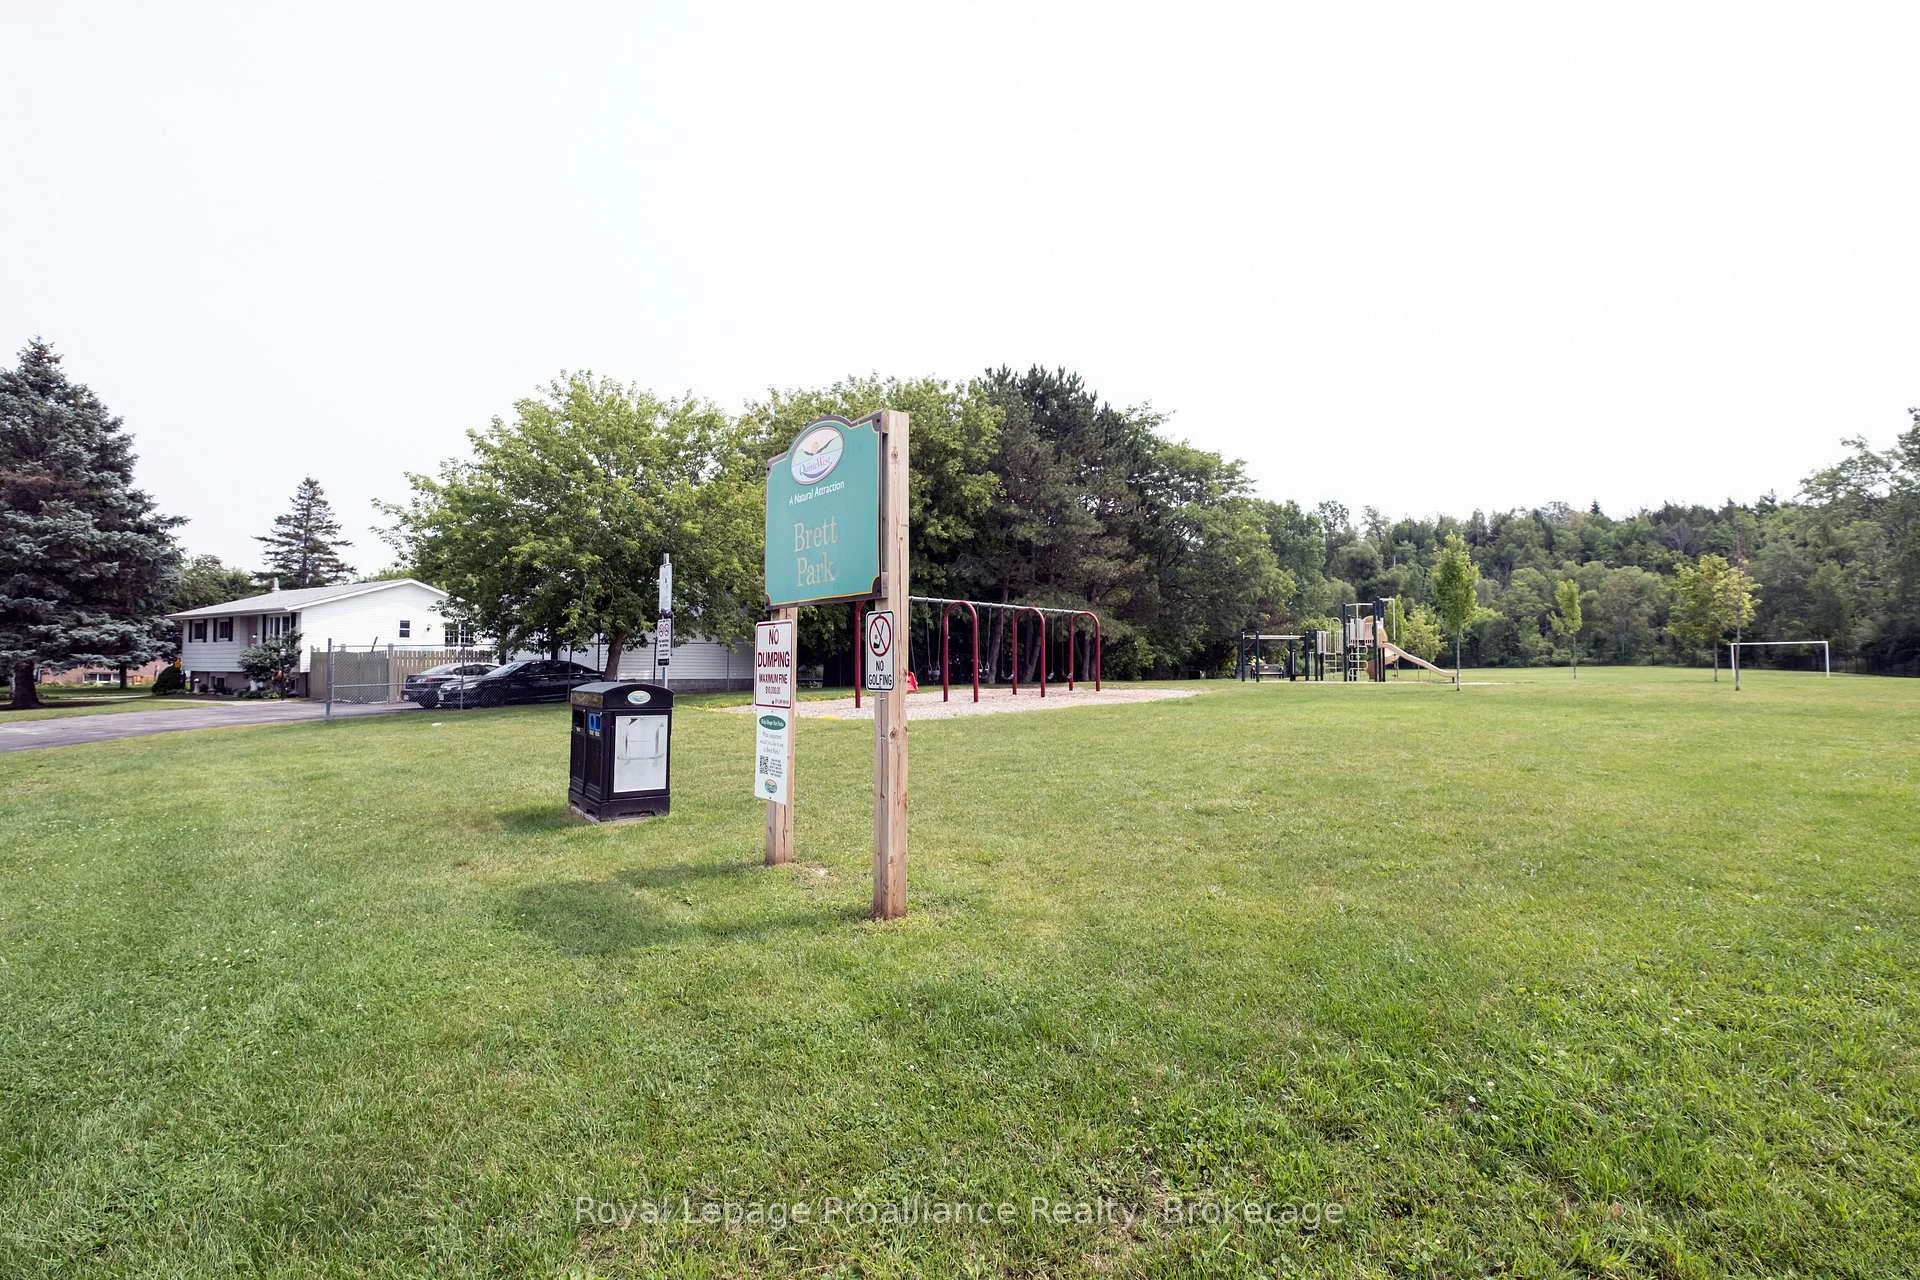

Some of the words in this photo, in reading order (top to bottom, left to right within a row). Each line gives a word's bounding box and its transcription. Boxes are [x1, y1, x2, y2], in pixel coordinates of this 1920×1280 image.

[794, 489, 814, 504] Natural
[815, 481, 845, 496] Attraction
[794, 516, 839, 552] Brett
[797, 552, 836, 586] Park
[768, 628, 780, 645] NO
[757, 651, 790, 668] DUMPING
[875, 660, 884, 671] NO
[759, 673, 778, 684] MAXIMUM
[869, 674, 892, 686] GOLFING
